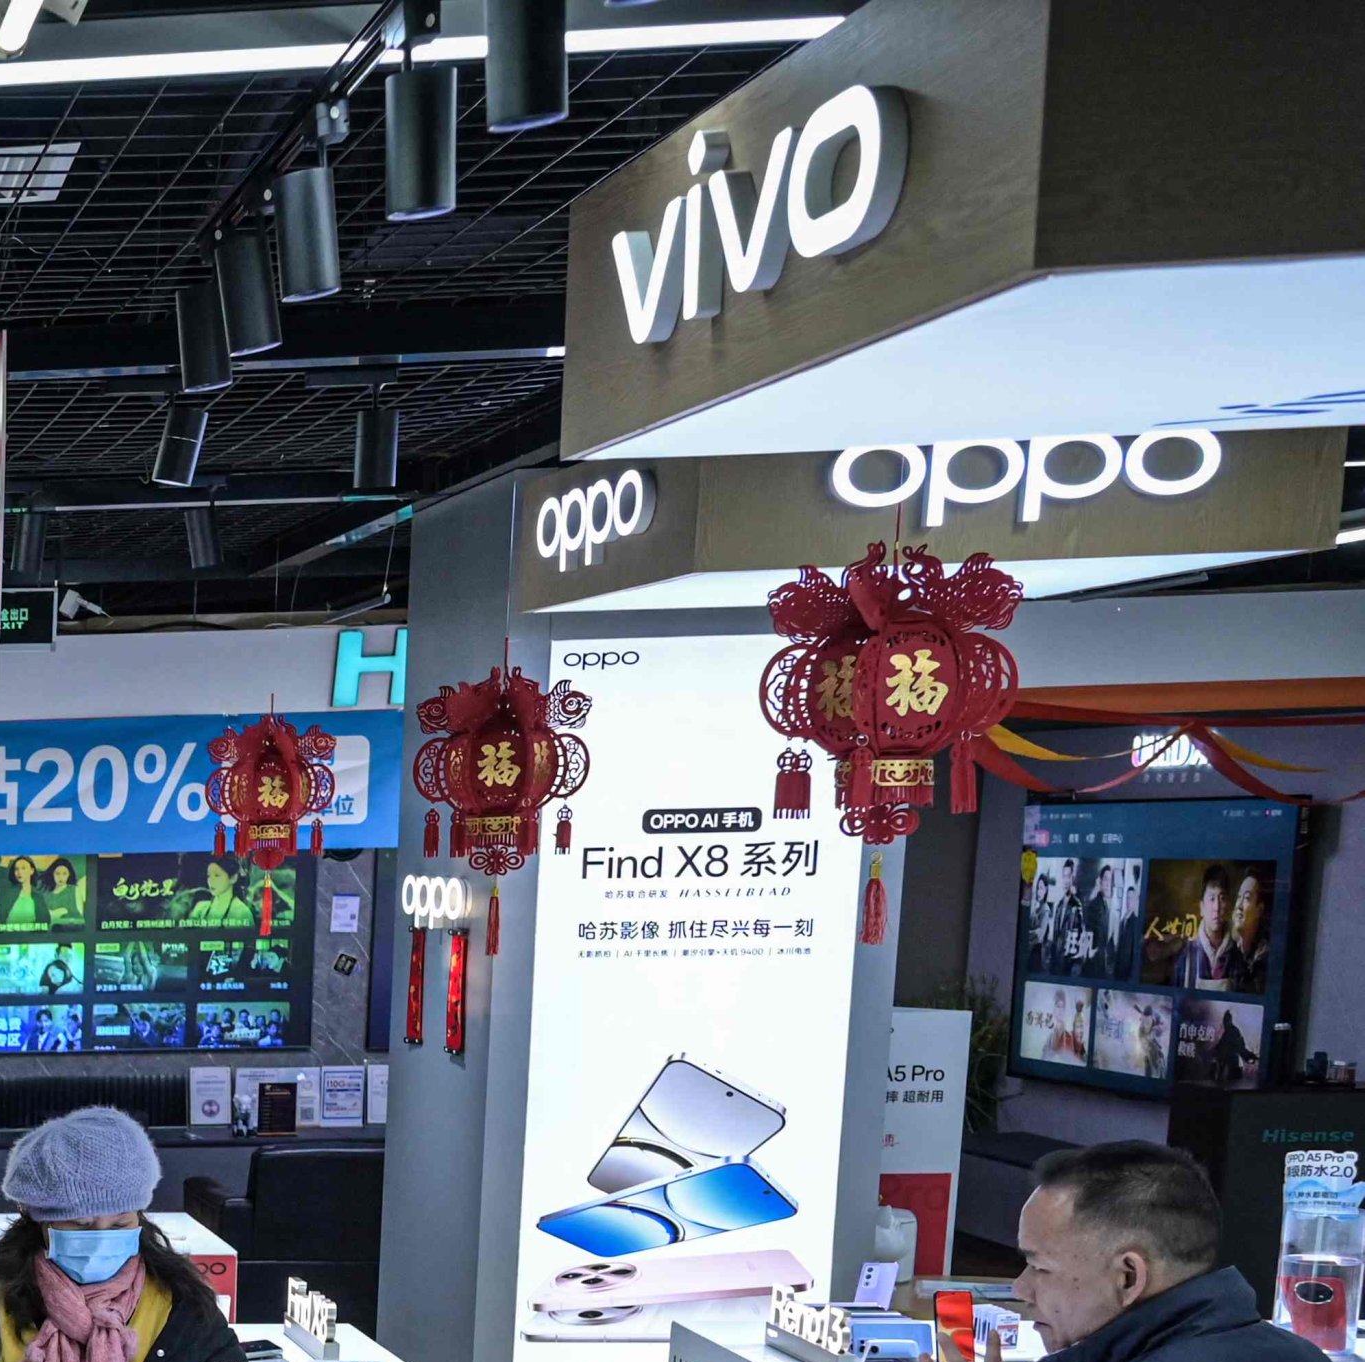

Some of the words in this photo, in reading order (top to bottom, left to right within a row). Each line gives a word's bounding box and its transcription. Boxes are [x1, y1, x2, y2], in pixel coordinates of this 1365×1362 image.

[613, 84, 900, 344] vivo
[884, 647, 950, 717] 福
[476, 740, 524, 788] 福
[257, 772, 290, 811] 福
[650, 814, 697, 829] OPPO
[701, 814, 719, 829] AI
[722, 812, 755, 830] 手机
[581, 848, 664, 880] Find
[674, 845, 730, 878] X8
[740, 840, 819, 878] 系列
[604, 888, 669, 900] 哈苏联合研发
[678, 886, 793, 899] HASSELBLAD
[577, 920, 661, 942] 哈苏影像
[668, 918, 815, 940] 抓住尽兴每一刻
[1143, 912, 1200, 943] 人世间
[740, 947, 765, 958] 9400
[910, 1064, 946, 1083] Pro
[901, 1089, 945, 1104] 超耐用
[1262, 1128, 1355, 1143] Hisense
[1306, 1153, 1322, 1163] A5
[1323, 1153, 1345, 1163] Pro
